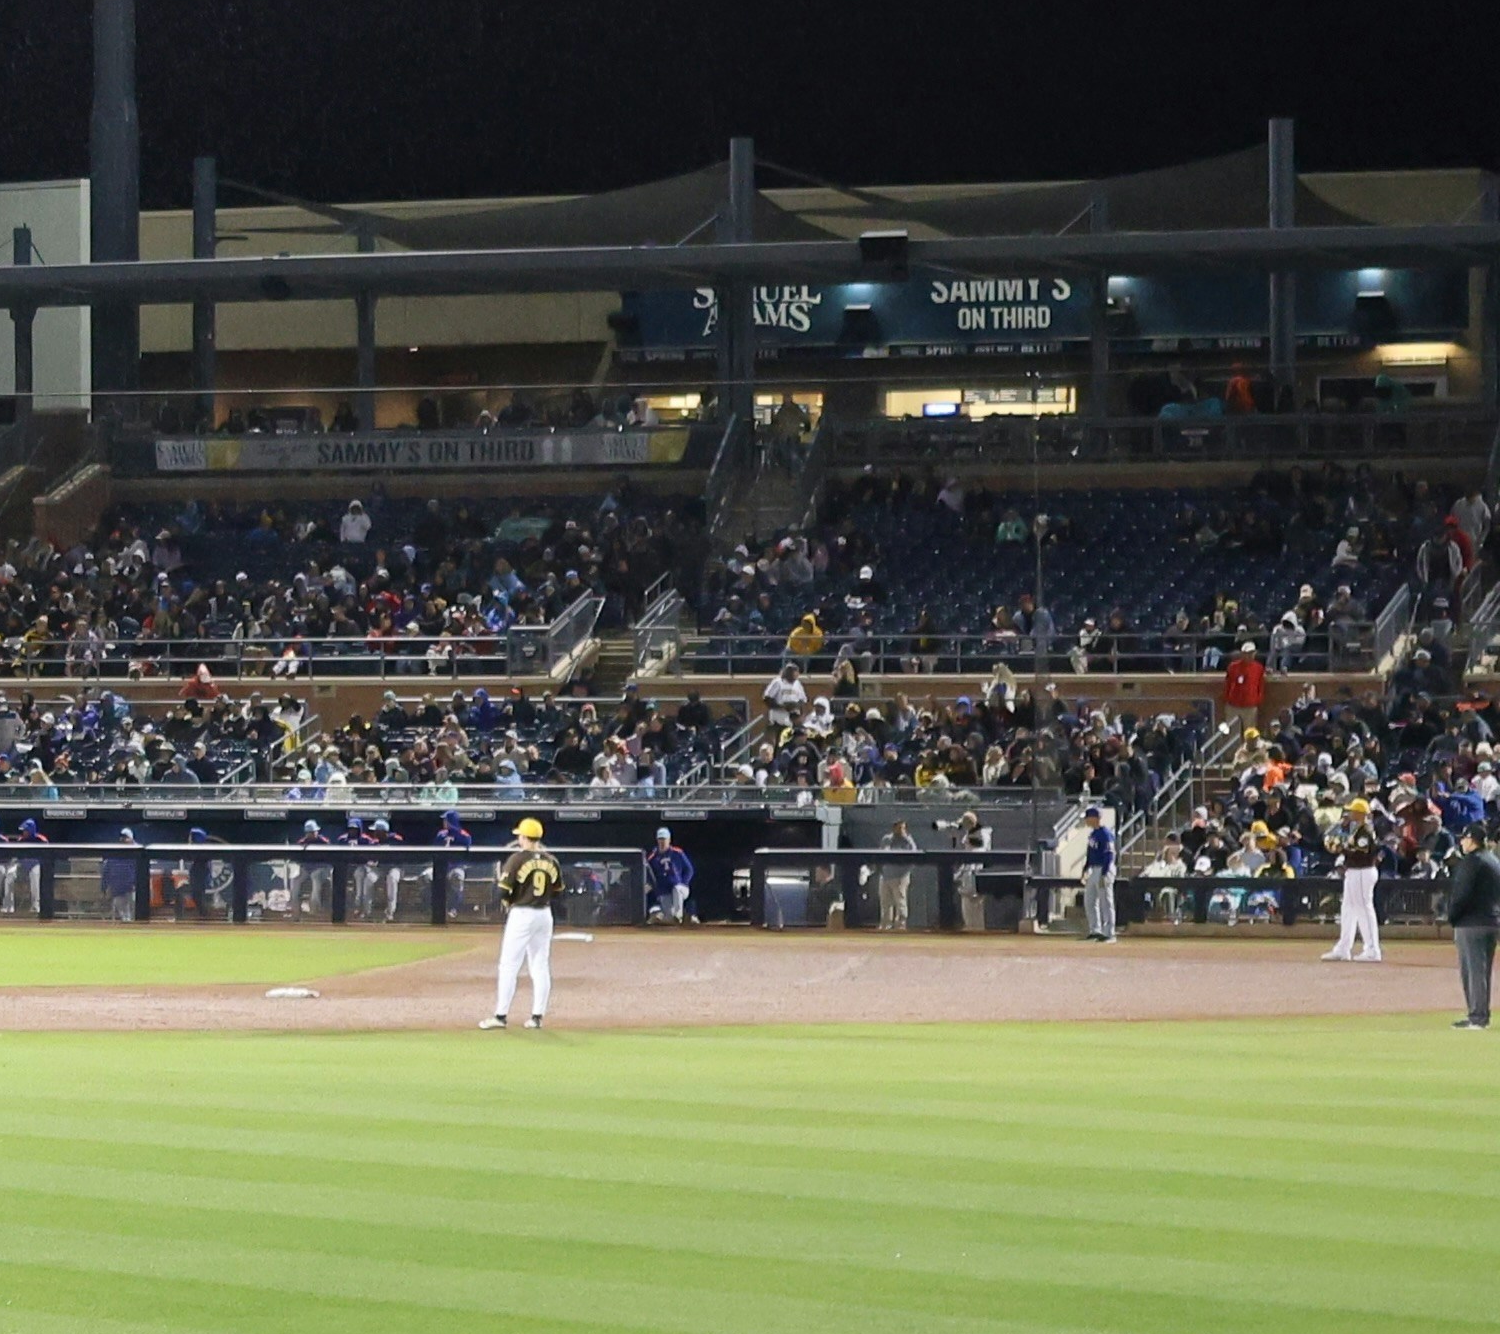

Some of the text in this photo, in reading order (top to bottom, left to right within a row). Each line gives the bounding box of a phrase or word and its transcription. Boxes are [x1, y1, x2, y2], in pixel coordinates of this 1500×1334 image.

[693, 285, 822, 309] SUEL
[930, 278, 1071, 304] SAMMYS
[702, 301, 812, 337] AAMS
[957, 306, 1051, 330] ON THIRD
[316, 440, 422, 465] SAMMY'S
[428, 439, 459, 463] ON
[468, 438, 535, 463] THIRD
[532, 870, 547, 897] 9
